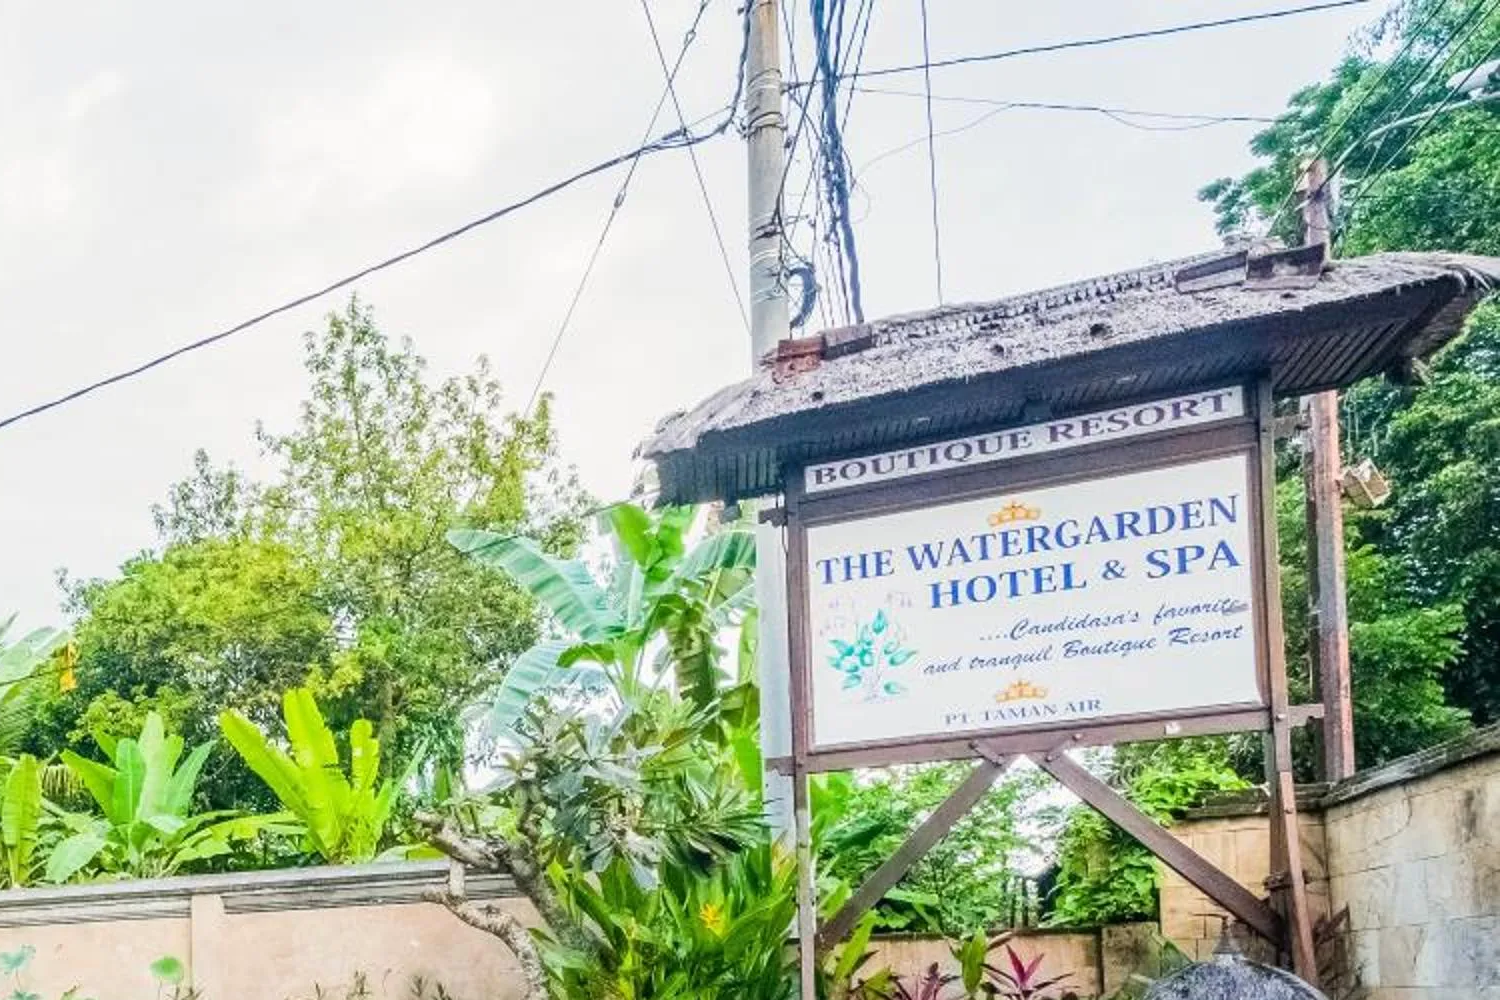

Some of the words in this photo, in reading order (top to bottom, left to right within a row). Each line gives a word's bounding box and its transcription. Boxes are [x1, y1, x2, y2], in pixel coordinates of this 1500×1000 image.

[813, 430, 1033, 486] BOUTIQUE
[1045, 390, 1234, 444] RESORT
[815, 549, 896, 586] THE
[906, 493, 1240, 571] WATERGARDEN
[927, 561, 1088, 609] HOTEL
[1101, 558, 1127, 581] &
[1144, 538, 1241, 579] SPA
[923, 656, 963, 676] and
[969, 644, 1053, 671] tranquil
[1061, 637, 1157, 659] Boutique
[1167, 624, 1244, 647] Resort
[984, 703, 1057, 723] TAMAN
[1064, 698, 1103, 714] AIR
